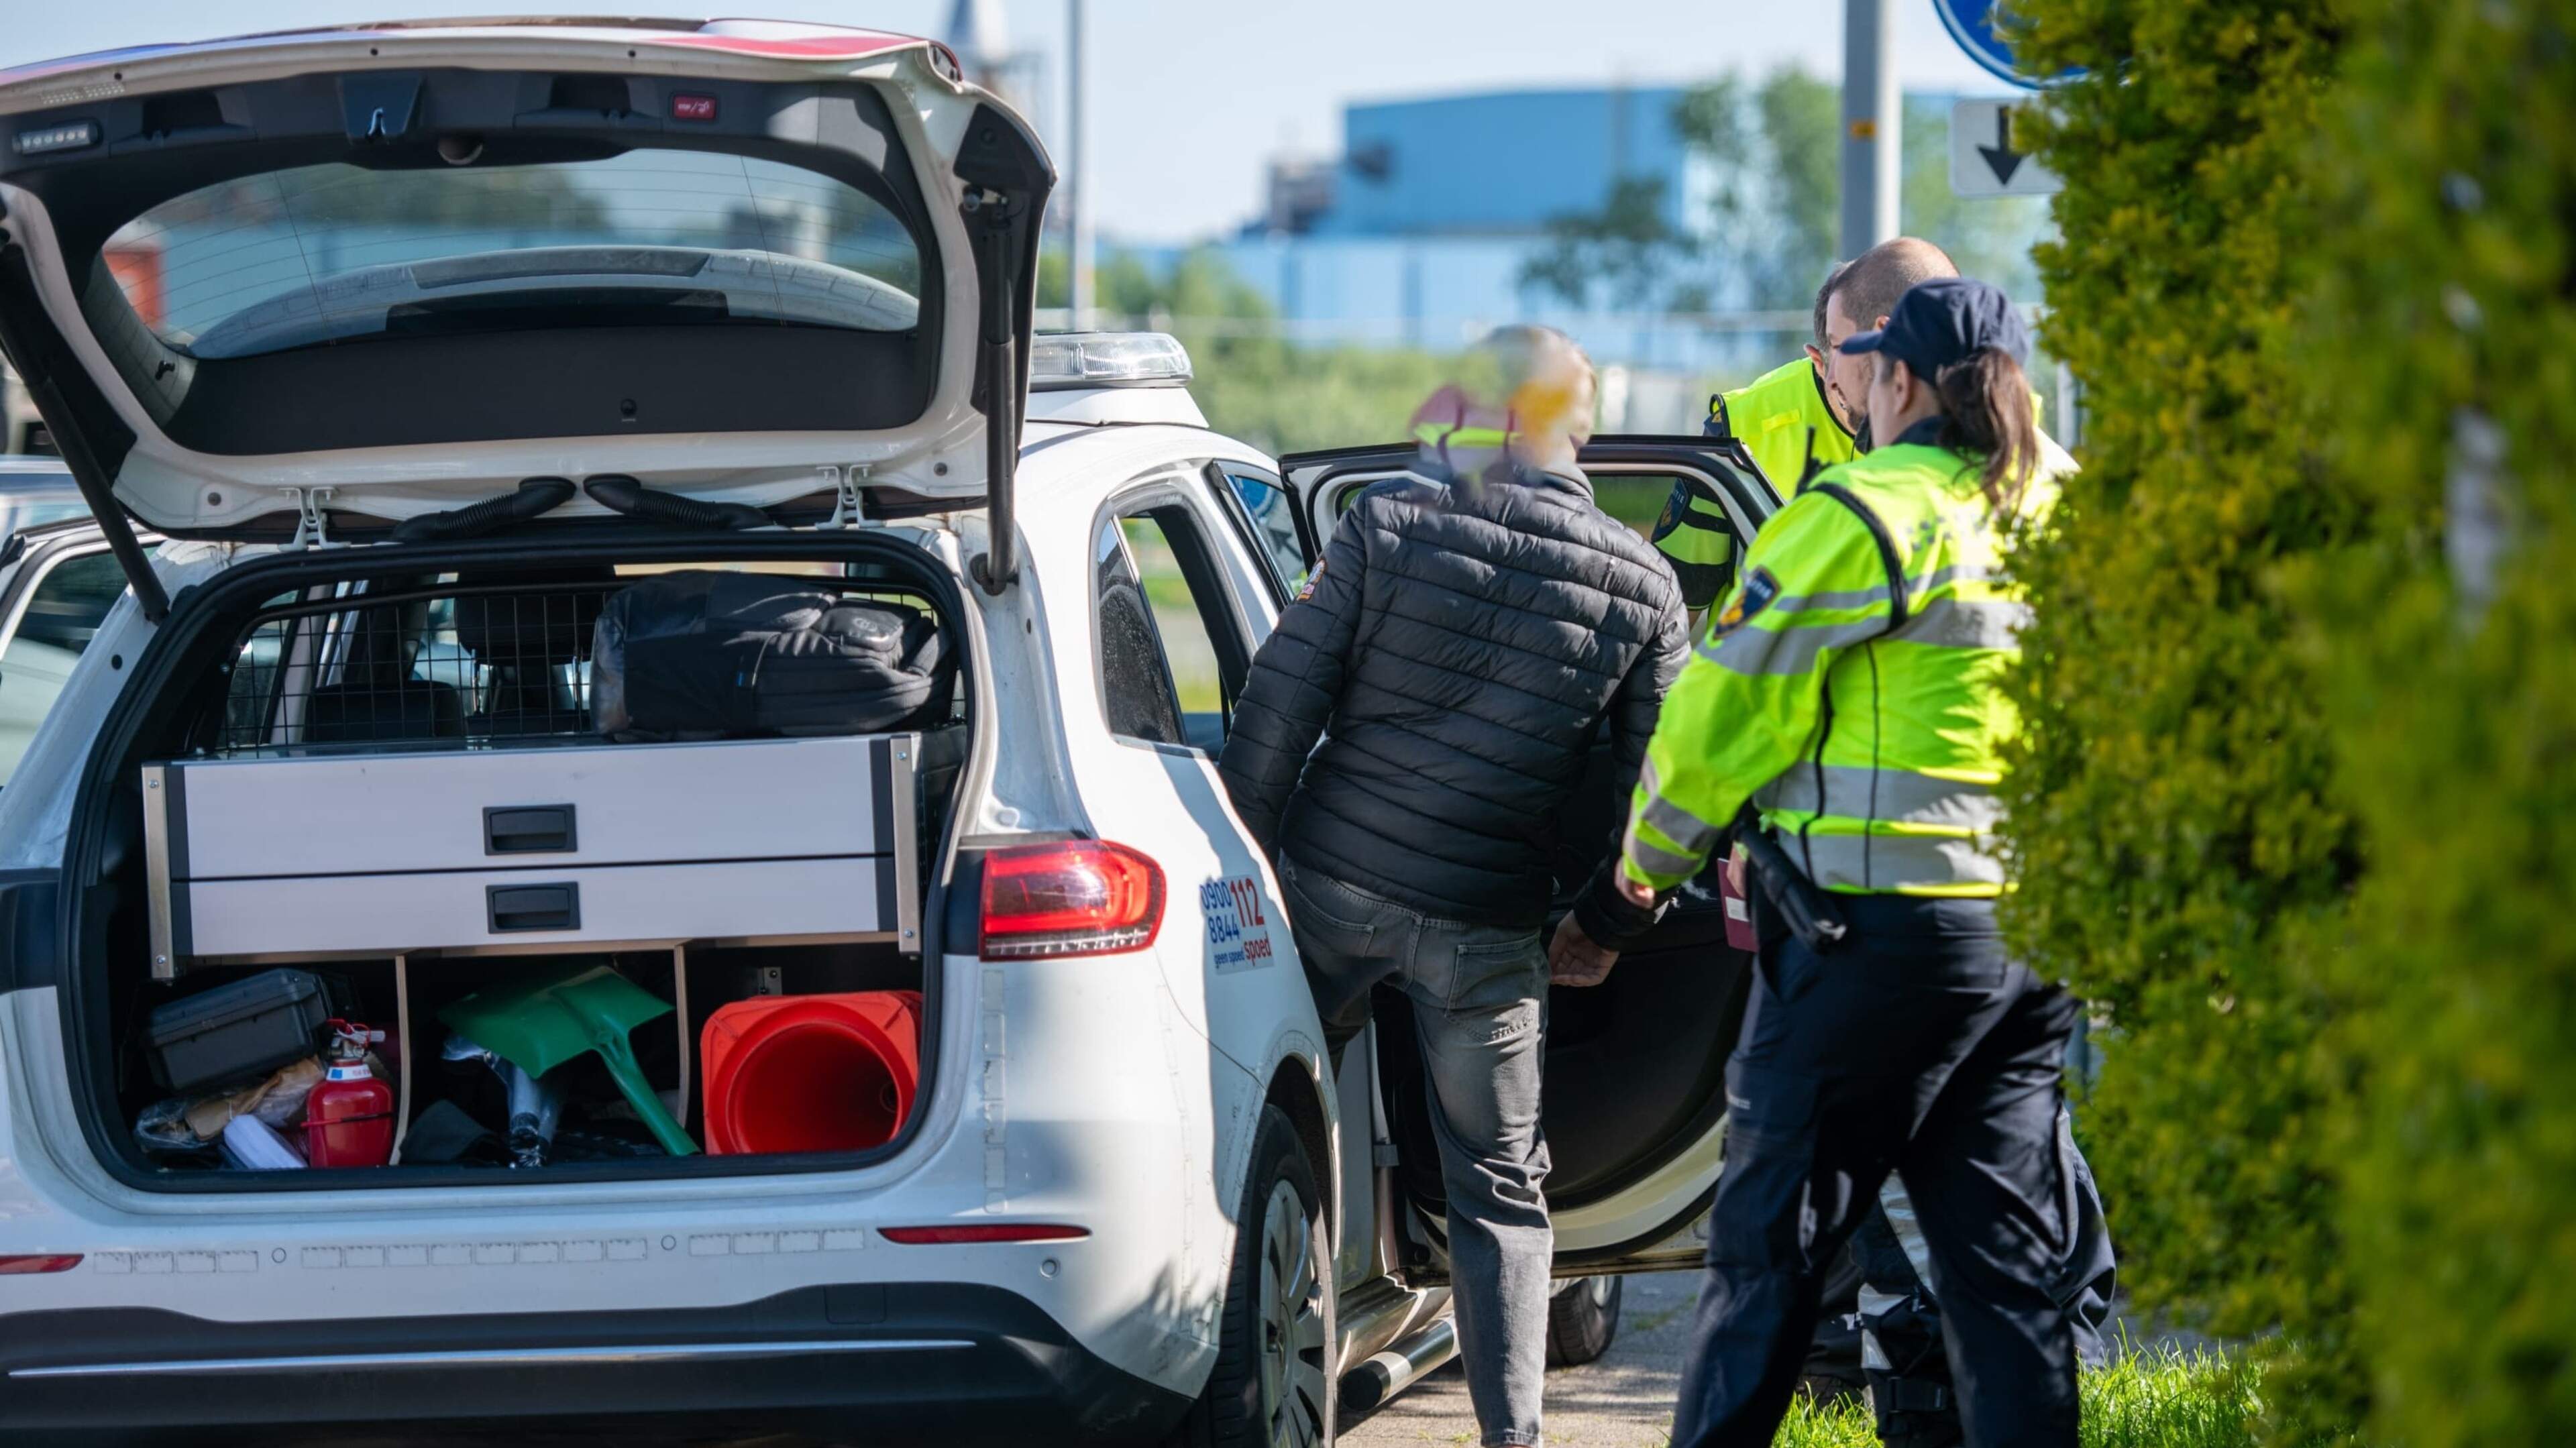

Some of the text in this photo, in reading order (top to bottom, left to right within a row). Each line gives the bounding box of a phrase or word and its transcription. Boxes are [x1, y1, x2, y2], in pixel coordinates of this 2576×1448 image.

[1199, 881, 1232, 909] 0900
[1230, 878, 1265, 928] 112
[1208, 914, 1240, 944] 8844
[1244, 931, 1271, 966] spoed
